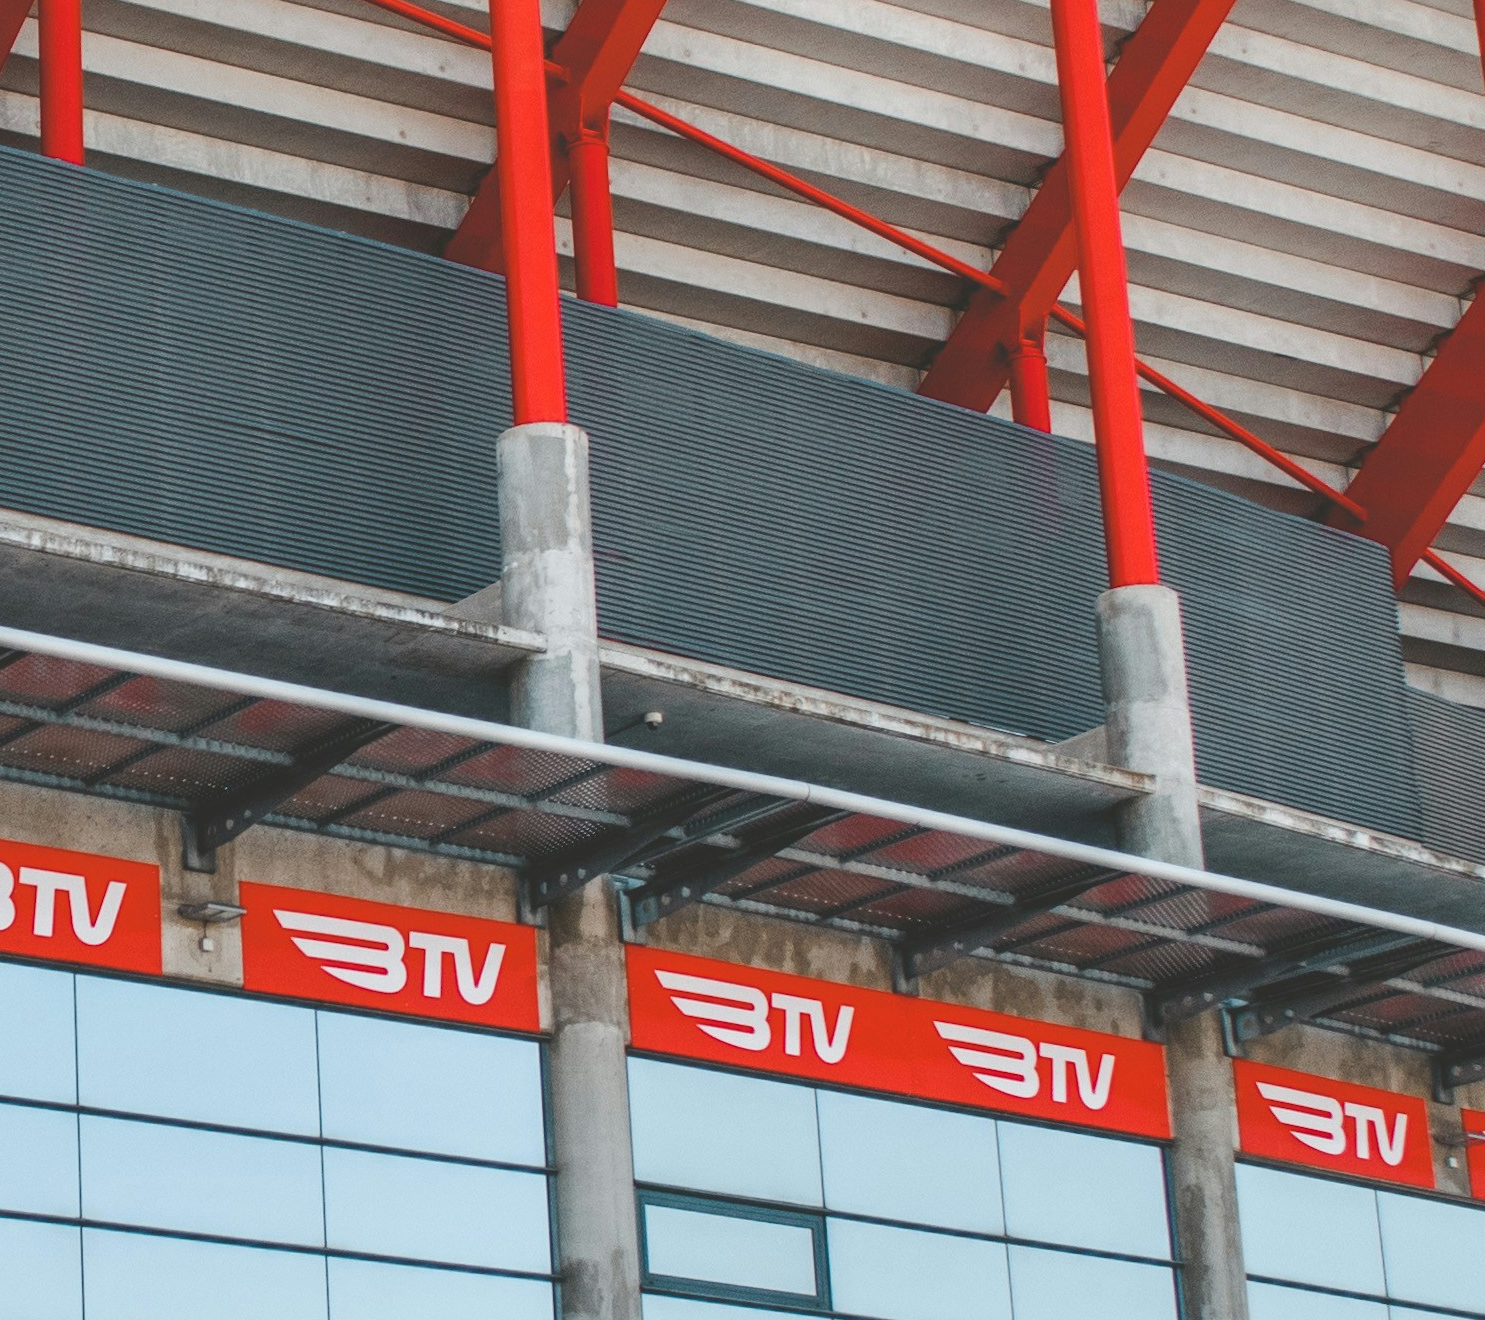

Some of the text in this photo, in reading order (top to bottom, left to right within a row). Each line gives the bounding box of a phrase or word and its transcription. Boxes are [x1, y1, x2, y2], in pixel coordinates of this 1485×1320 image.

[273, 909, 507, 1006] BTV
[653, 969, 856, 1065] BTV
[932, 1020, 1116, 1111] BTV
[1256, 1081, 1409, 1167] BTV
